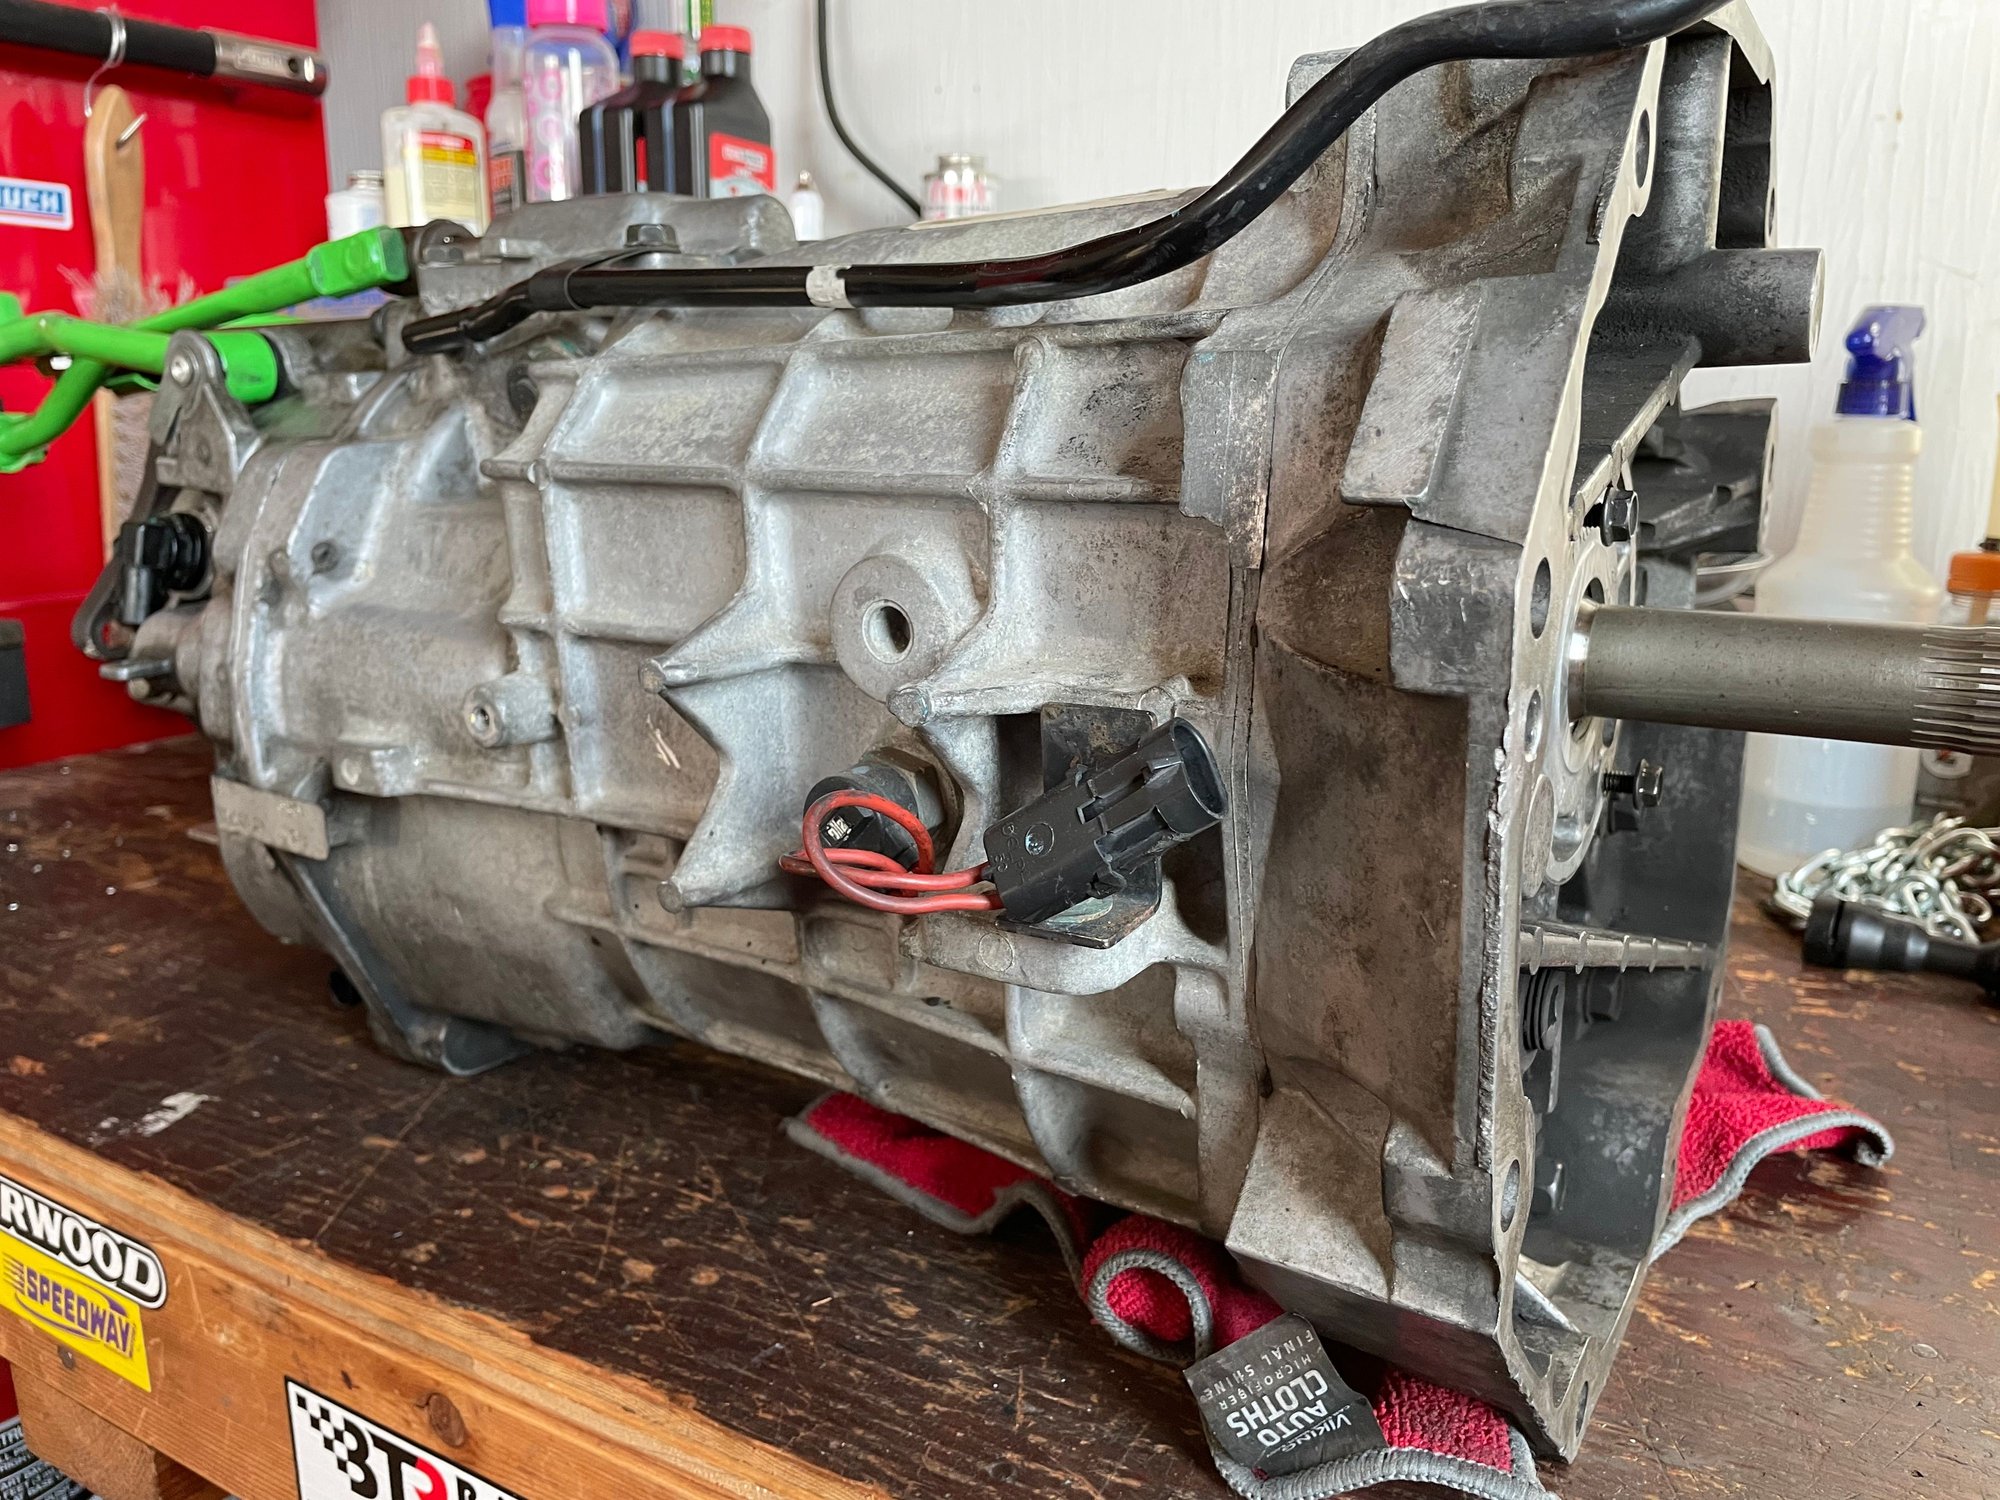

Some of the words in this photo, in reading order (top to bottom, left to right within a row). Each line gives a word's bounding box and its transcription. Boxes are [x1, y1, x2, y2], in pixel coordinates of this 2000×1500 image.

[1, 1182, 160, 1298] RWOOD
[26, 1267, 131, 1353] SPEEDWAY
[1261, 1329, 1315, 1366] FINAL
[1219, 1354, 1312, 1410] MICROFIBER
[1226, 1369, 1328, 1438] CLOTHS
[1257, 1400, 1328, 1447] AUTO
[1282, 1413, 1352, 1453] VIKING
